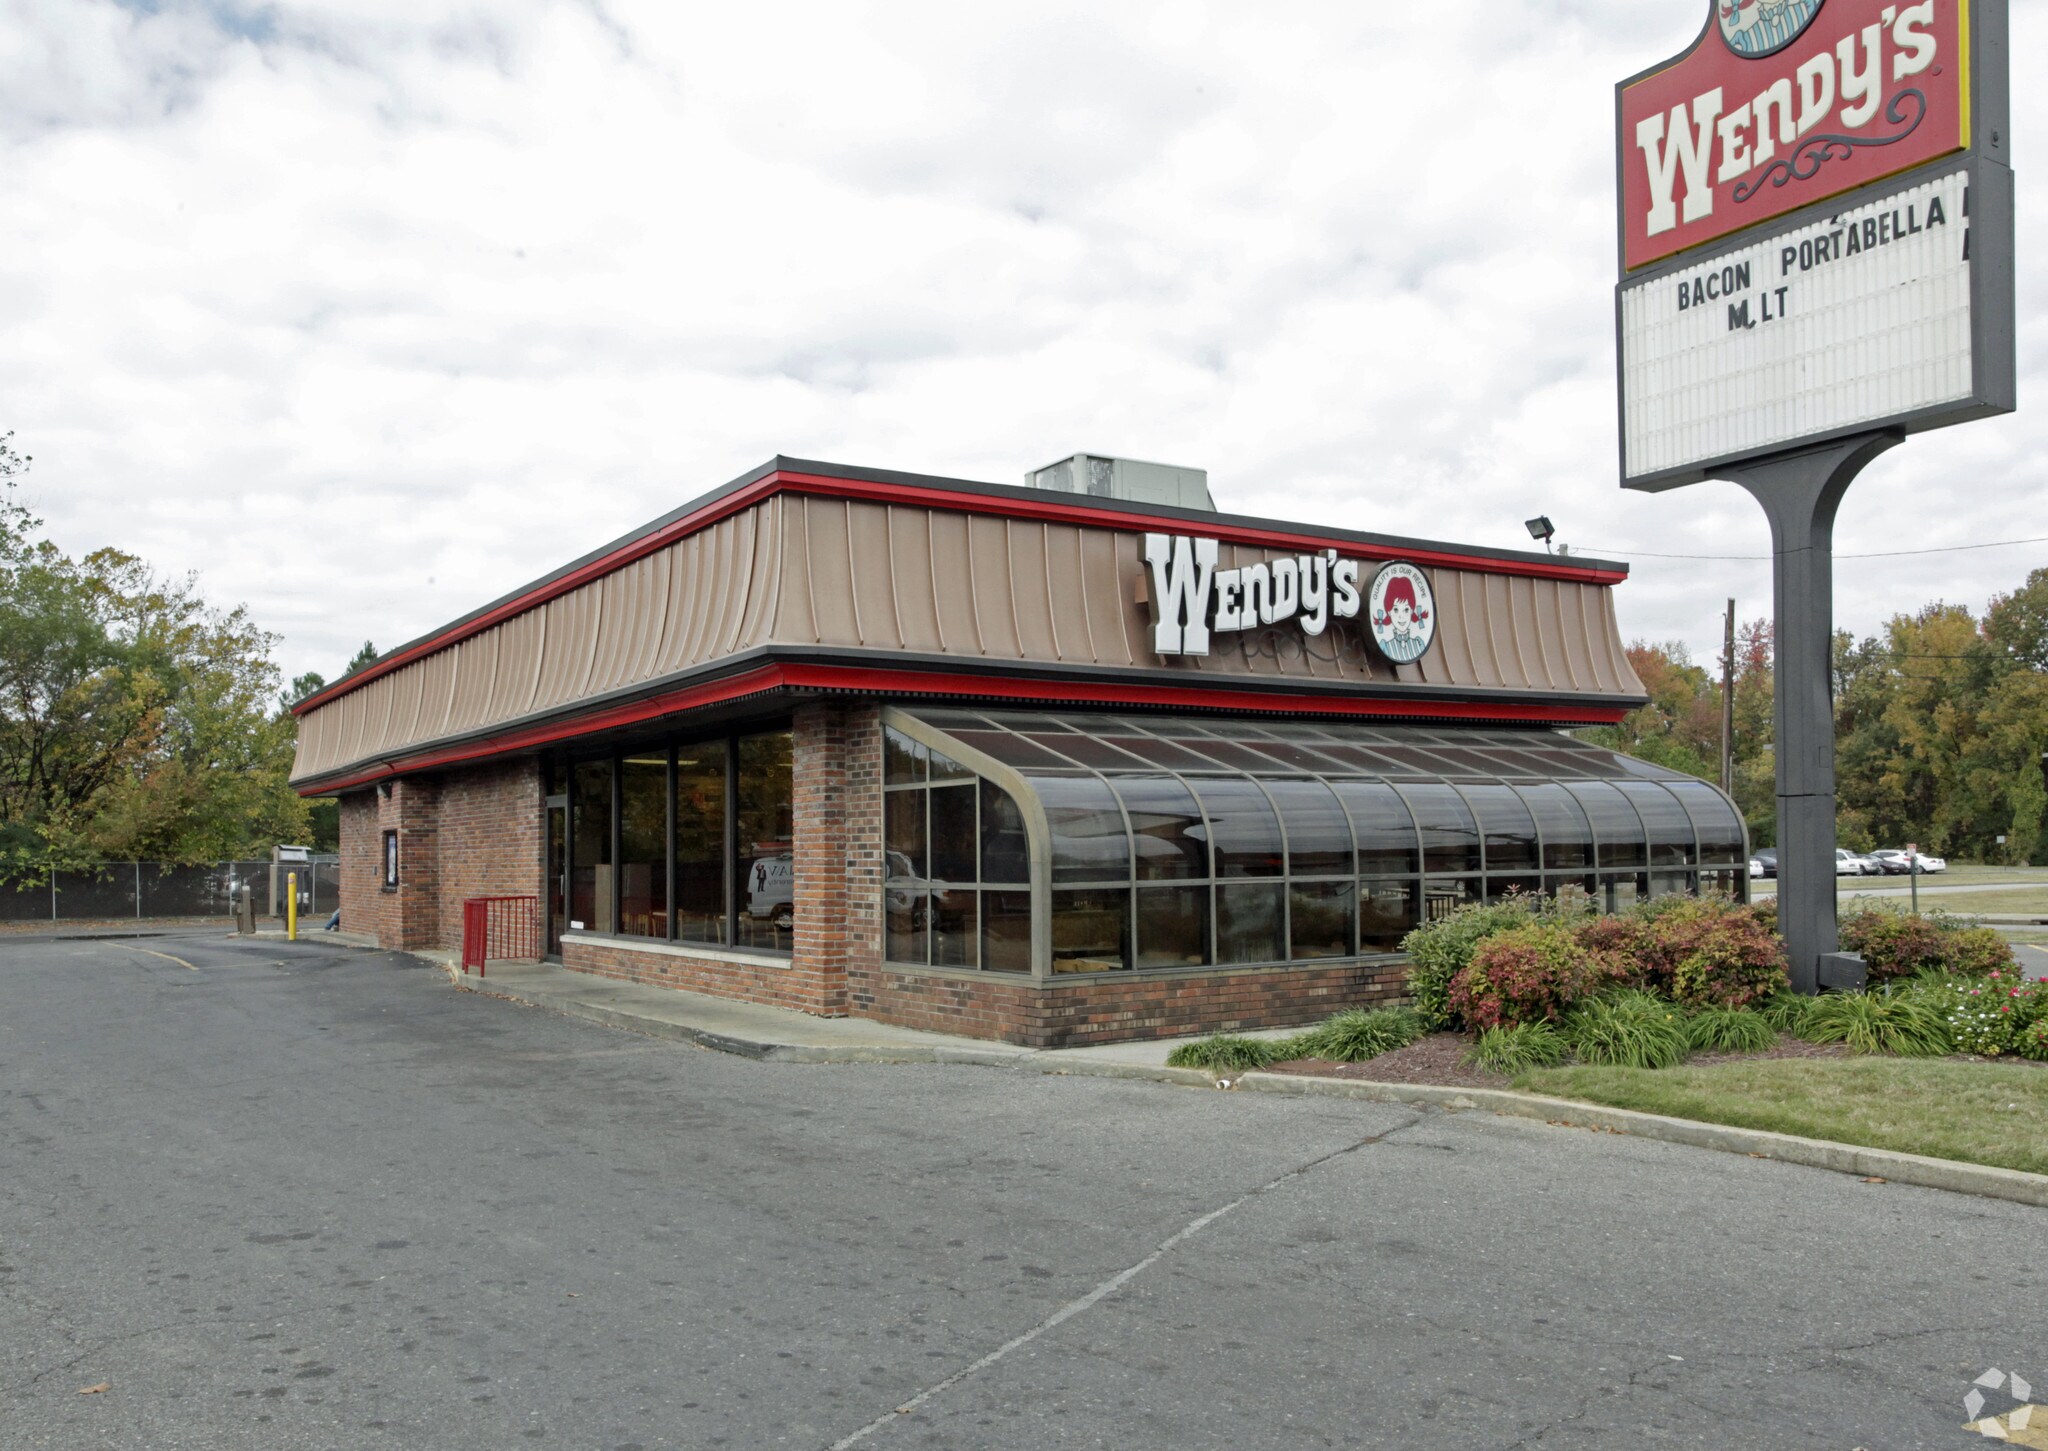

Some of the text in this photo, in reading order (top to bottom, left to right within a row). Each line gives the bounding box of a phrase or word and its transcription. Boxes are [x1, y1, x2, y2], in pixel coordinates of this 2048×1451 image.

[1678, 260, 1751, 311] BACON
[1781, 195, 1946, 276] PORTABELLA
[1373, 571, 1389, 600] QUALITY
[1399, 566, 1412, 575] OUR
[1412, 573, 1427, 599] RECIPE
